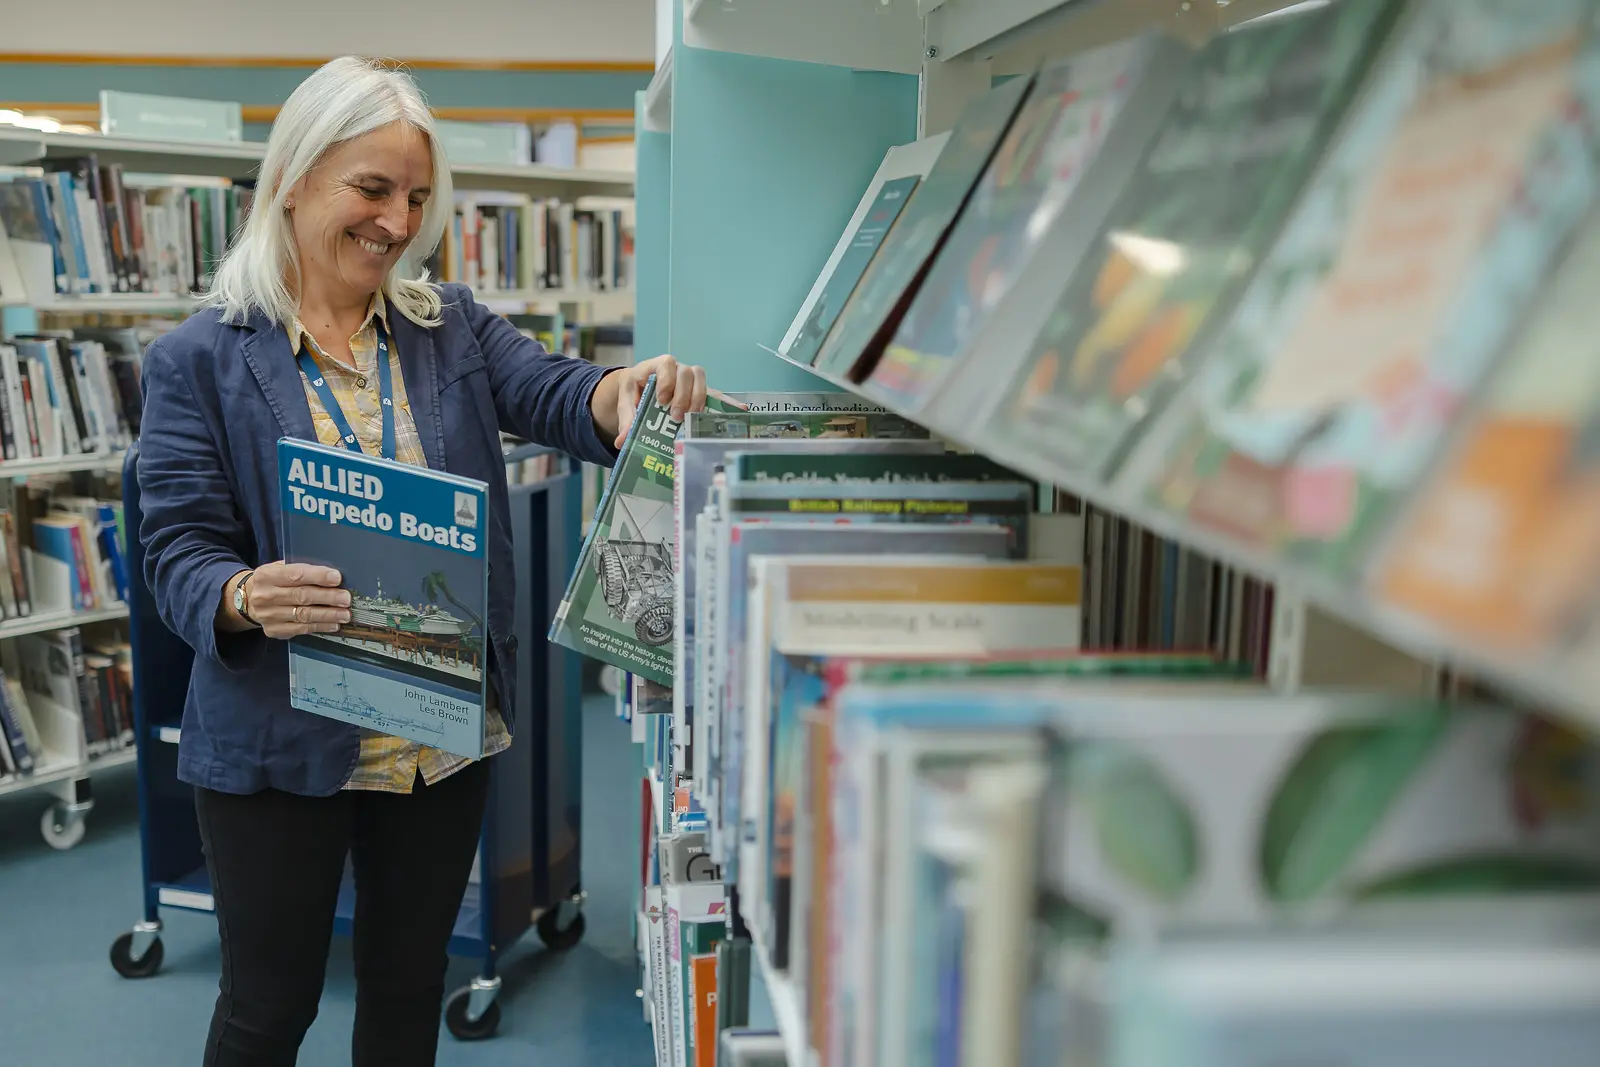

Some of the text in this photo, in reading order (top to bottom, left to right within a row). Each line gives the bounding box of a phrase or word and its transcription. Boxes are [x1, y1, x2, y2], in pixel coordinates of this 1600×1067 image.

[646, 411, 677, 439] JE
[641, 435, 660, 448] 1940
[288, 458, 384, 501] ALLIED
[288, 485, 477, 552] Torpedo Boats
[789, 499, 839, 512] British
[841, 499, 902, 514] Railway
[580, 624, 590, 634] An
[590, 628, 611, 641] insight
[611, 637, 623, 646] into
[624, 640, 635, 650] the
[657, 655, 674, 666] deve
[583, 636, 599, 647] roles
[599, 642, 607, 650] of
[607, 645, 618, 654] the
[618, 648, 629, 658] US
[629, 653, 650, 666] Army's
[650, 662, 665, 671] light
[404, 688, 469, 715] John Lambert
[419, 703, 469, 725] Les Brown
